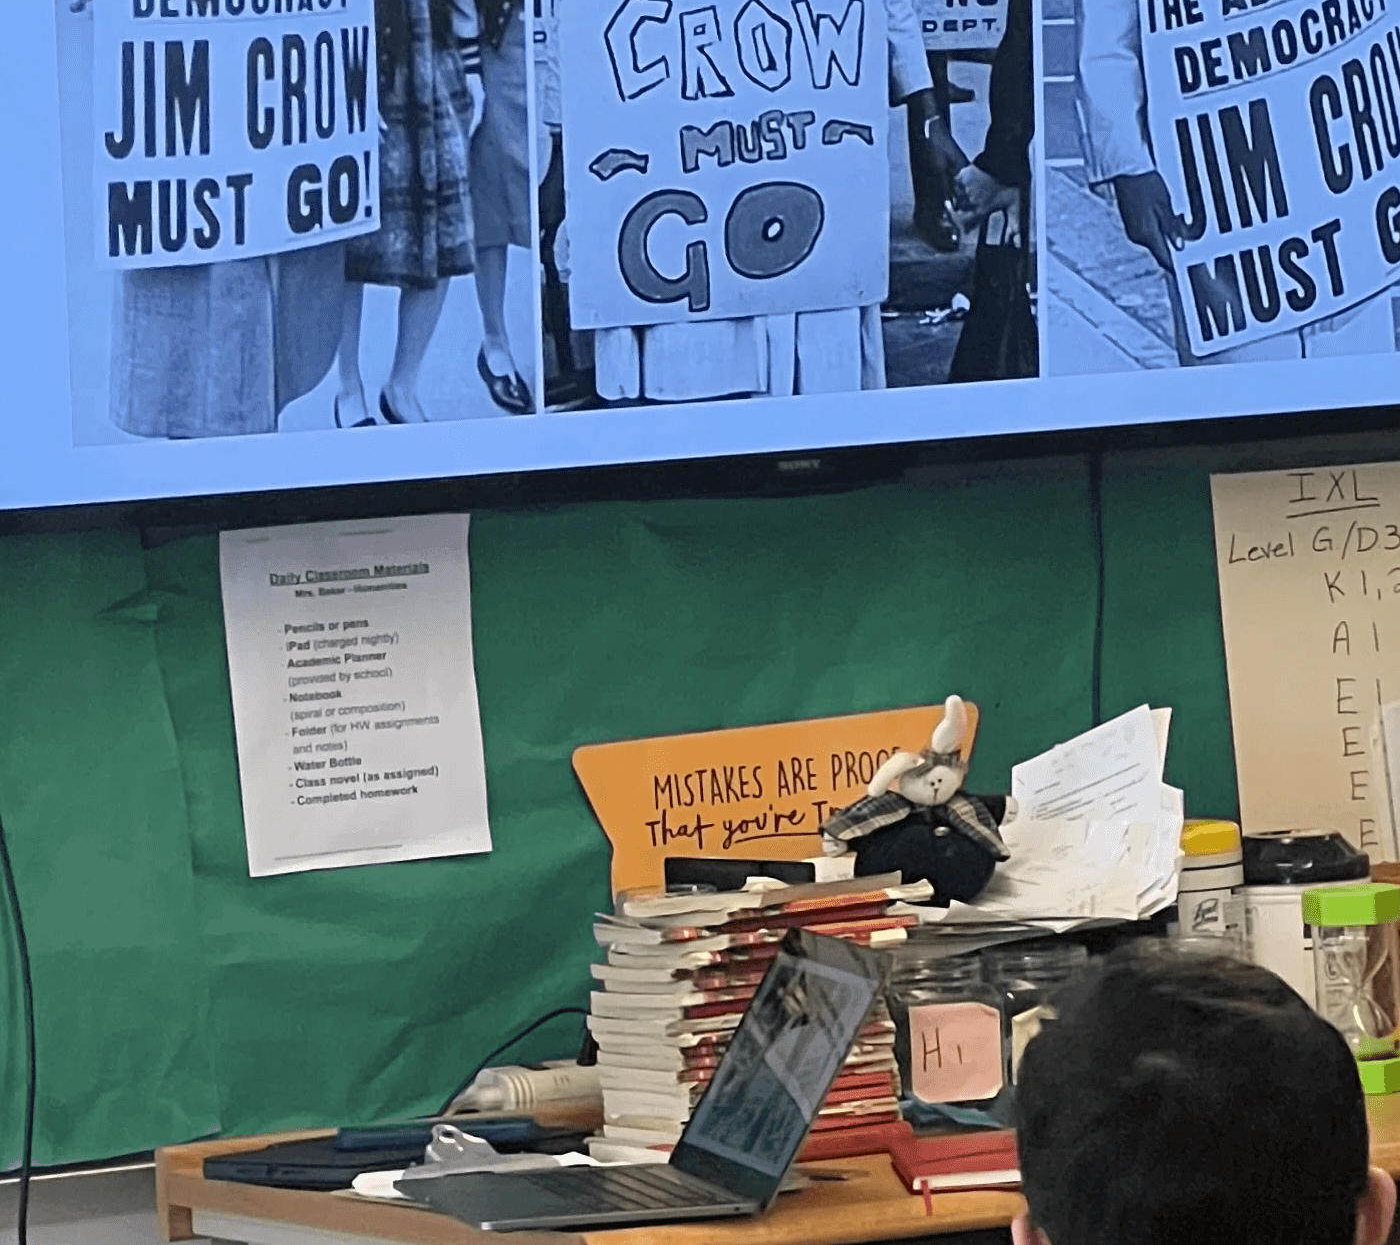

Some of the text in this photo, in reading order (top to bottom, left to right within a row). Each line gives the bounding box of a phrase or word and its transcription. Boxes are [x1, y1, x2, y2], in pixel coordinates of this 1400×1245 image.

[104, 26, 370, 159] JIM CROW
[680, 110, 815, 173] MUST
[1176, 97, 1289, 241] JIM
[108, 150, 373, 257] MUST GO!
[618, 181, 824, 312] GO
[1187, 218, 1343, 341] MUST
[1287, 469, 1379, 504] IXL
[1229, 532, 1294, 563] Level
[270, 562, 429, 586] Daily Classroom Materials
[285, 623, 325, 634] Pencils
[343, 620, 368, 631] pens
[314, 636, 358, 651] (charged
[361, 632, 399, 646] nightly)
[287, 653, 386, 668] Academic Planner
[289, 667, 392, 687] (provided by school)
[290, 690, 341, 702] Notebook
[291, 709, 322, 721] (spiral
[338, 701, 405, 715] composition)
[292, 716, 439, 736] Folder (for HW assignments
[293, 740, 347, 754] and notes)
[1342, 726, 1365, 756] E
[294, 757, 361, 770] Water Bottle
[296, 766, 438, 788] Class novel (as assigned)
[654, 747, 900, 810] MISTAKES ARE PROO
[1350, 770, 1368, 801] E
[297, 786, 417, 805] Completed homework
[723, 803, 806, 849] you're
[1360, 818, 1378, 847] E
